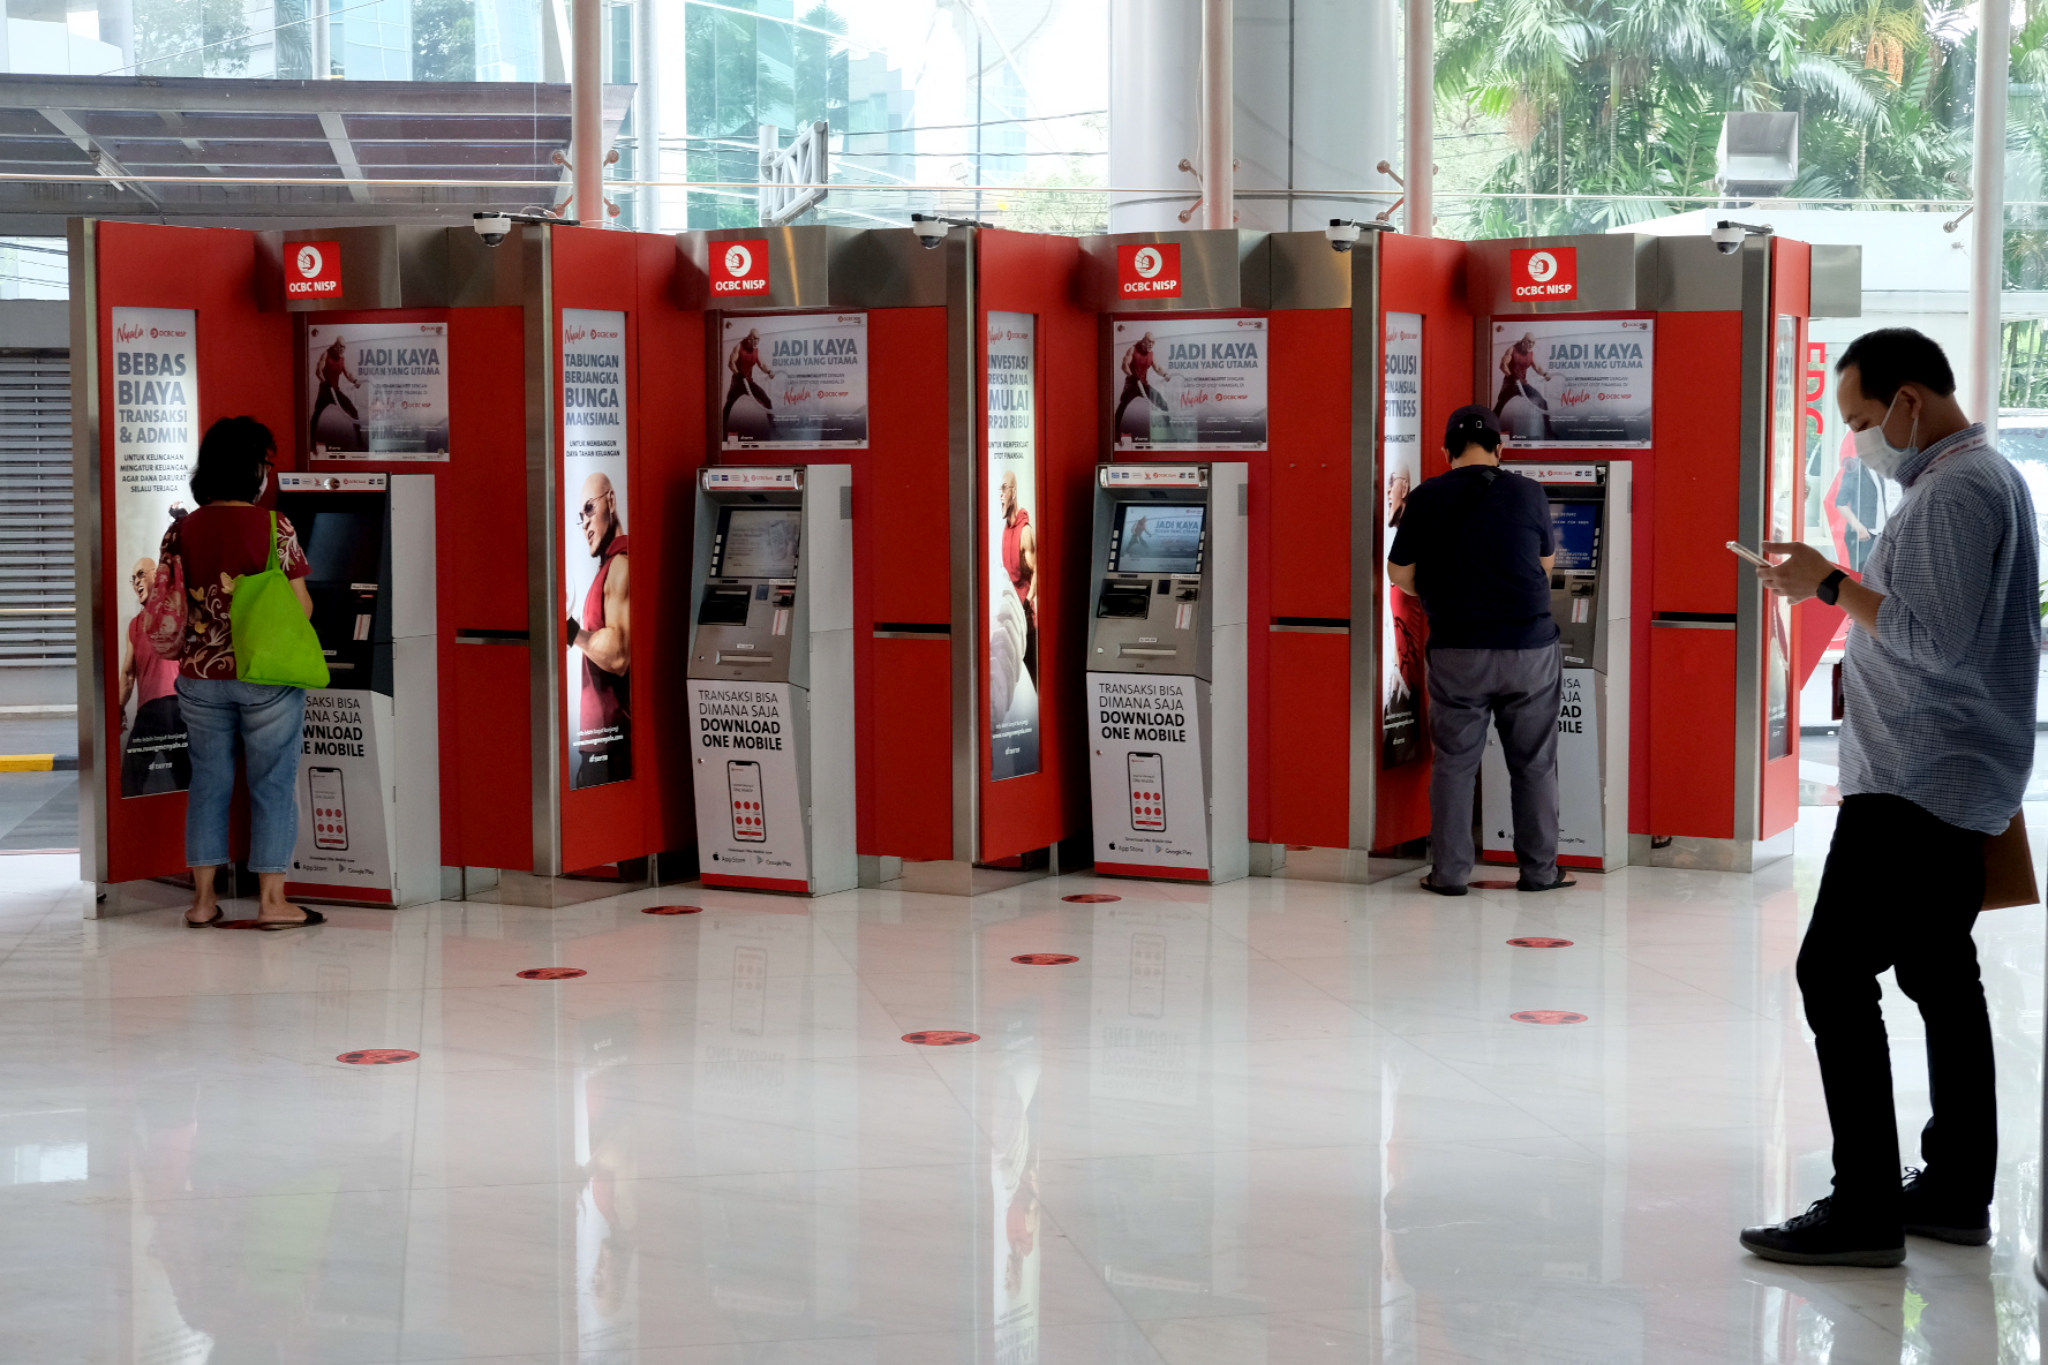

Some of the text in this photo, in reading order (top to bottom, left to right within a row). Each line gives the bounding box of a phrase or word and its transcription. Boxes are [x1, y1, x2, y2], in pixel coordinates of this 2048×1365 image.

[289, 281, 337, 293] OCBC NISP
[715, 279, 766, 291] OCBC NISP
[1124, 280, 1177, 292] OCBC NISP
[1516, 284, 1572, 296] OCBC NISP
[772, 338, 857, 357] JADI KAYA
[1168, 343, 1258, 360] JADI KAYA
[1549, 343, 1643, 360] JADI KAYA
[118, 352, 187, 376] BEBAS
[358, 348, 440, 367] JADI KAYA
[565, 354, 619, 368] TABUNGAN
[772, 356, 858, 366] BUKAN YANG UTAMA
[988, 355, 1029, 370] INVESTASI
[1385, 354, 1417, 375] SOLUSI
[358, 367, 440, 376] BUKAN YANG UTAMA
[1168, 360, 1258, 370] BUKAN YANG UTAMA
[1548, 360, 1643, 370] BUKAN YANG UTAMA
[565, 371, 619, 385] BERJANGKA
[988, 373, 1028, 385] REKSA DANA
[118, 380, 186, 405] BIAYA
[565, 388, 619, 408] BUNGA
[784, 386, 812, 406] Nyala
[1180, 390, 1208, 408] Nyala
[1561, 389, 1591, 407] Nyala
[989, 389, 1029, 411] MULAI
[119, 409, 187, 423] TRANSAKSI
[566, 412, 620, 426] MAKSIMAL
[988, 415, 1029, 429] RP20 RIBU
[120, 426, 187, 443] & ADMIN
[124, 453, 145, 461] UNTUK
[1004, 452, 1024, 460] FINANSIAL
[120, 464, 154, 472] MENGATUR
[1176, 520, 1199, 530] KAYA
[1099, 683, 1184, 696] TRANSAKSI BISA
[1563, 679, 1581, 689] ISA
[307, 696, 361, 709] SAKSI BISA
[698, 690, 778, 703] TRANSAKSI BISA
[1099, 696, 1184, 711] DIMANA SAJA
[304, 710, 362, 724] ANA SAJA
[699, 702, 779, 718] DIMANA SAJA
[700, 718, 781, 734] DOWNLOAD
[1100, 711, 1185, 727] DOWNLOAD
[303, 725, 363, 740] WNLOAD
[1102, 726, 1186, 742] ONE MOBILE
[315, 742, 365, 757] MOBILE
[702, 734, 782, 751] ONE MOBILE
